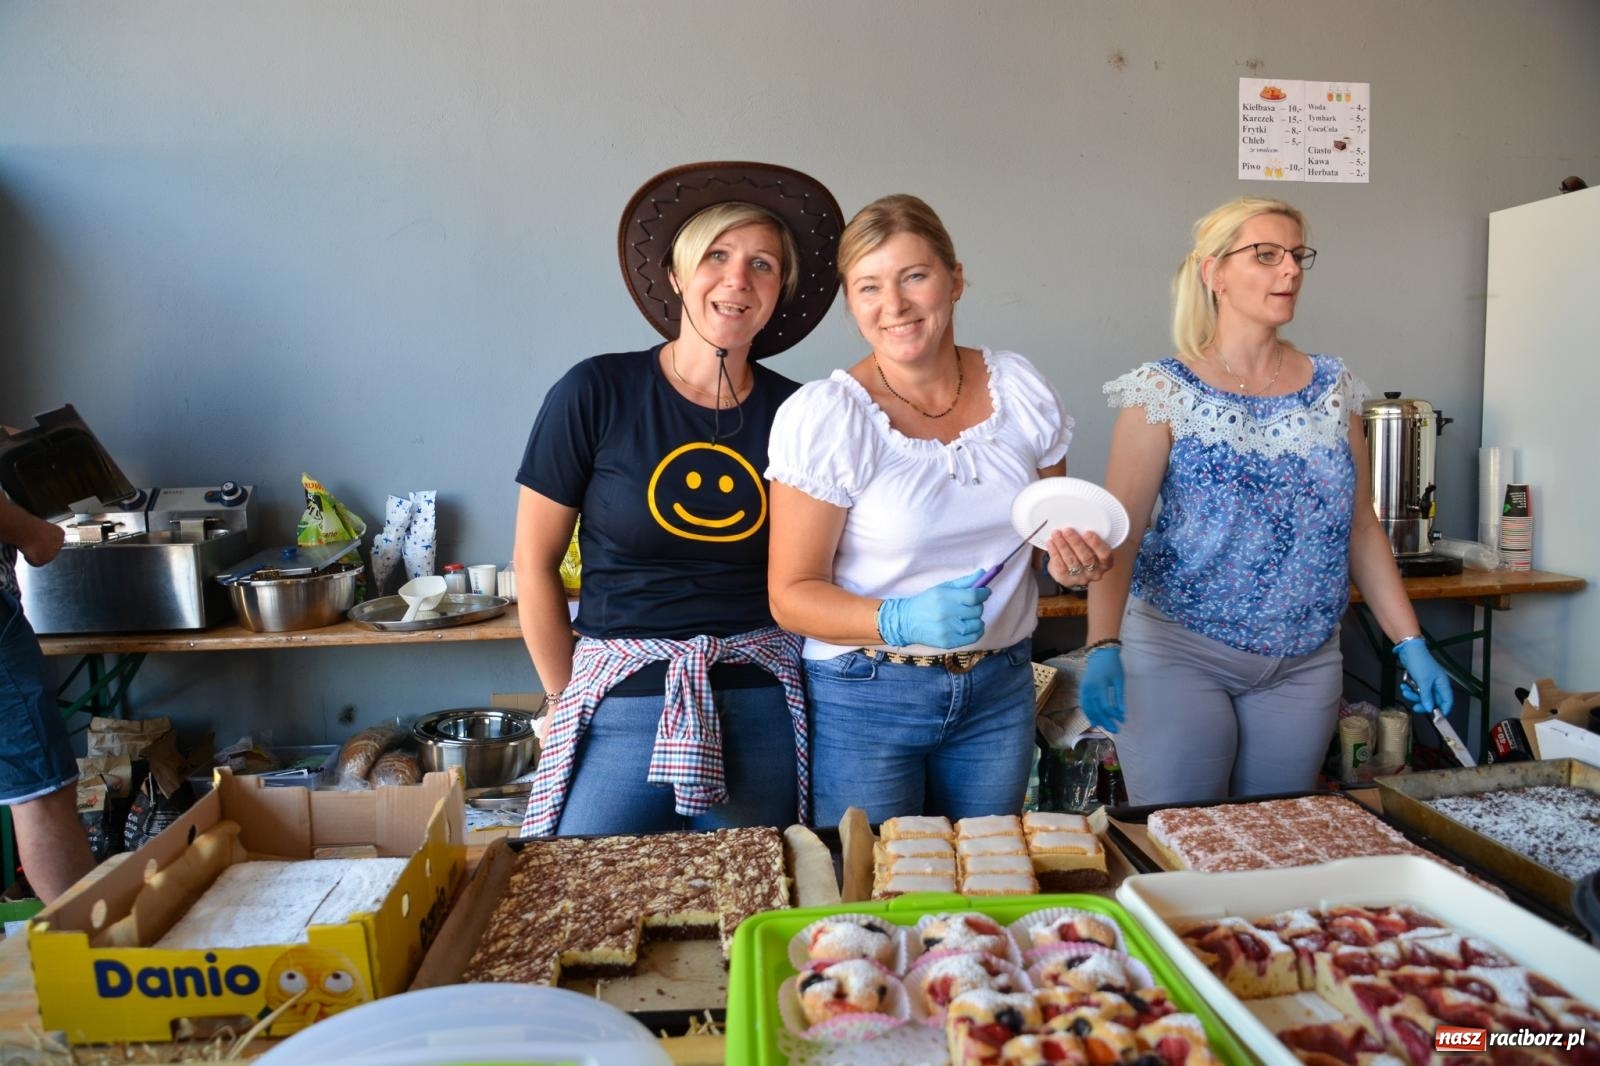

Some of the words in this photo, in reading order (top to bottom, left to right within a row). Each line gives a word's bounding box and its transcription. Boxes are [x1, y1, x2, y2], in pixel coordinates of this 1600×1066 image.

[1242, 114, 1274, 122] Karczek
[1309, 114, 1336, 122] Tymbark
[1242, 125, 1267, 135] Frytki
[1242, 136, 1265, 144] Chleb
[1307, 146, 1332, 154] Ciasto
[1308, 157, 1330, 165] Kawa
[1242, 162, 1261, 170] Piwo
[1308, 168, 1339, 176] Herbata
[93, 952, 261, 998] Danio
